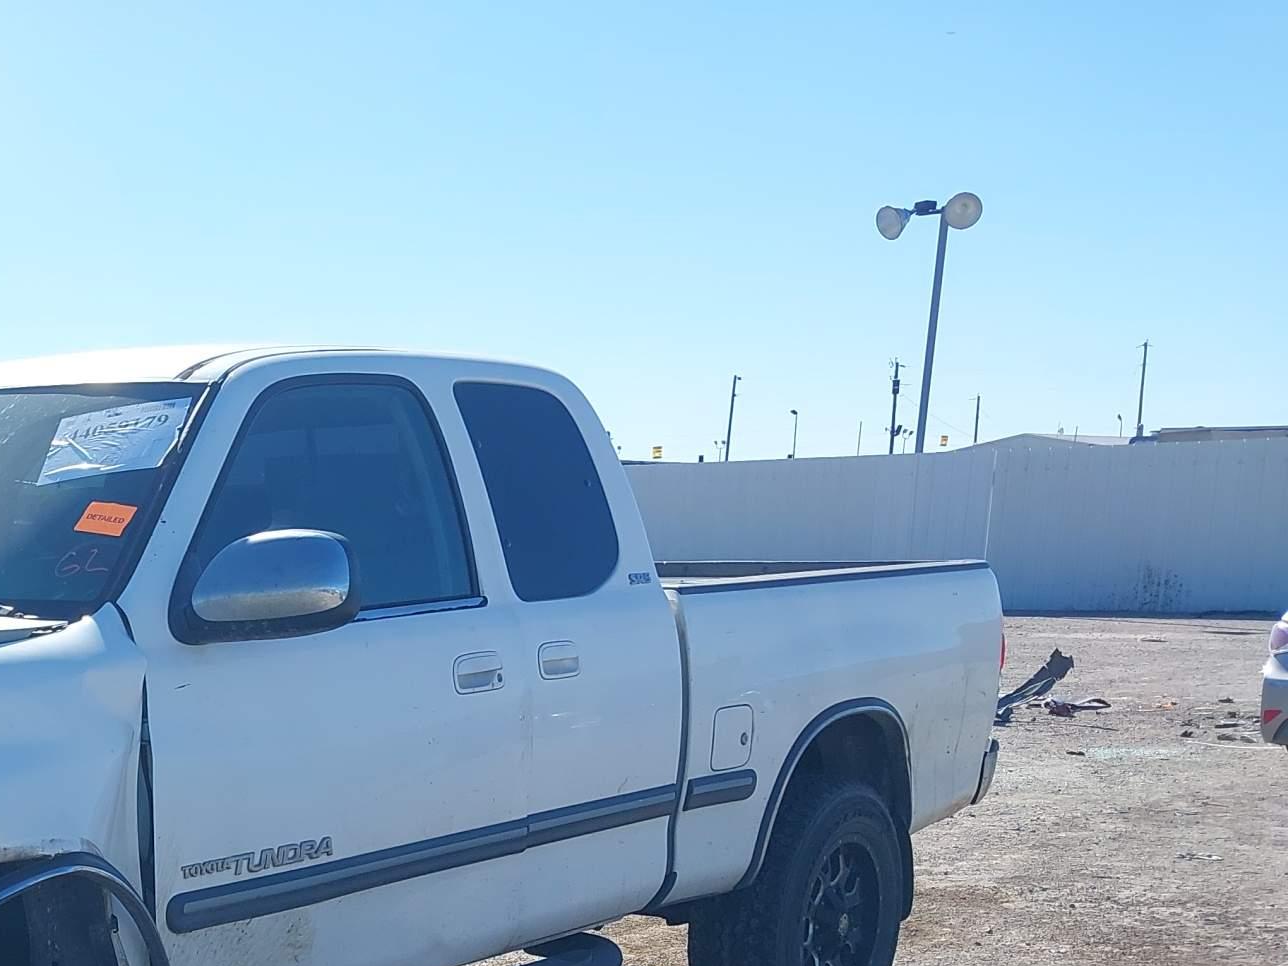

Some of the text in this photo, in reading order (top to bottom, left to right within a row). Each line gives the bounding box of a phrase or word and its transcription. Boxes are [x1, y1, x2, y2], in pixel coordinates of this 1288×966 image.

[86, 513, 125, 524] DETAILED
[181, 836, 333, 879] TOYOTA TUNDRA
